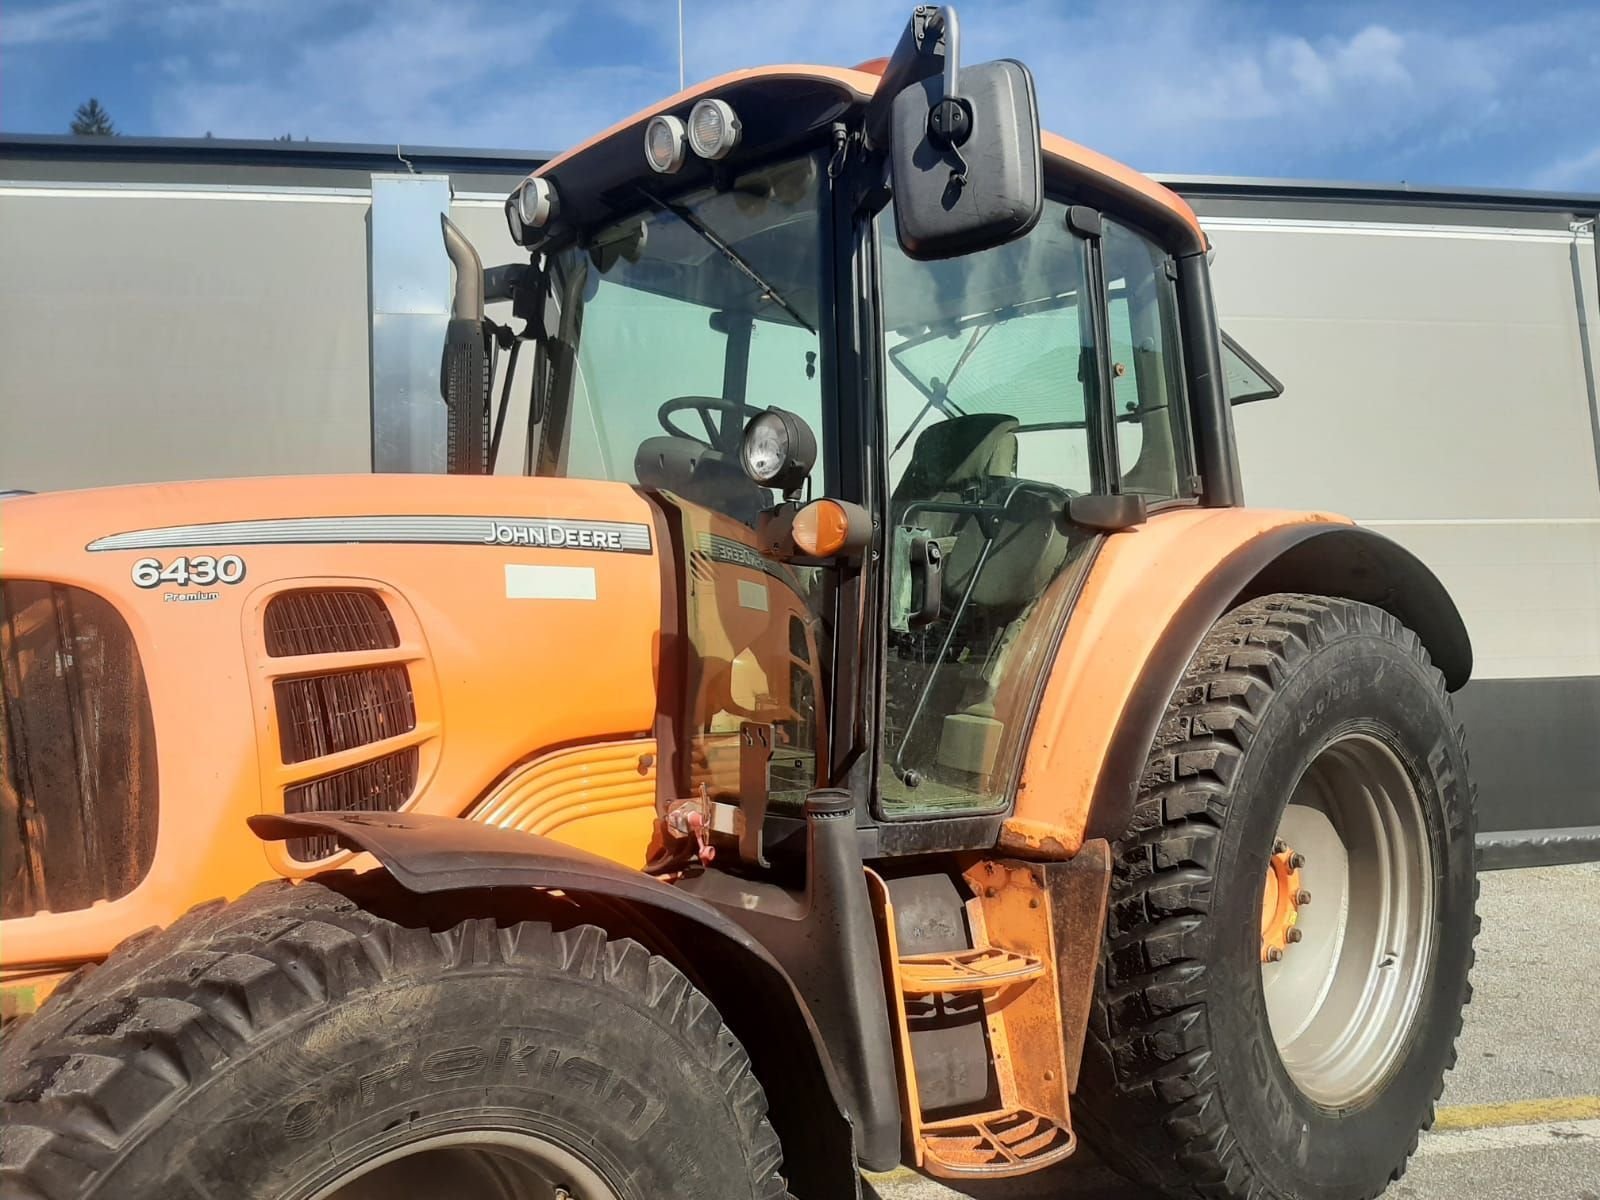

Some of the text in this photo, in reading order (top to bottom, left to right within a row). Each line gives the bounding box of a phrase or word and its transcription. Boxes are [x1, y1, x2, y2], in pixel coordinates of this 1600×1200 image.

[484, 521, 622, 551] JOHN DEERE
[131, 555, 246, 589] 6430
[164, 591, 220, 602] Premium
